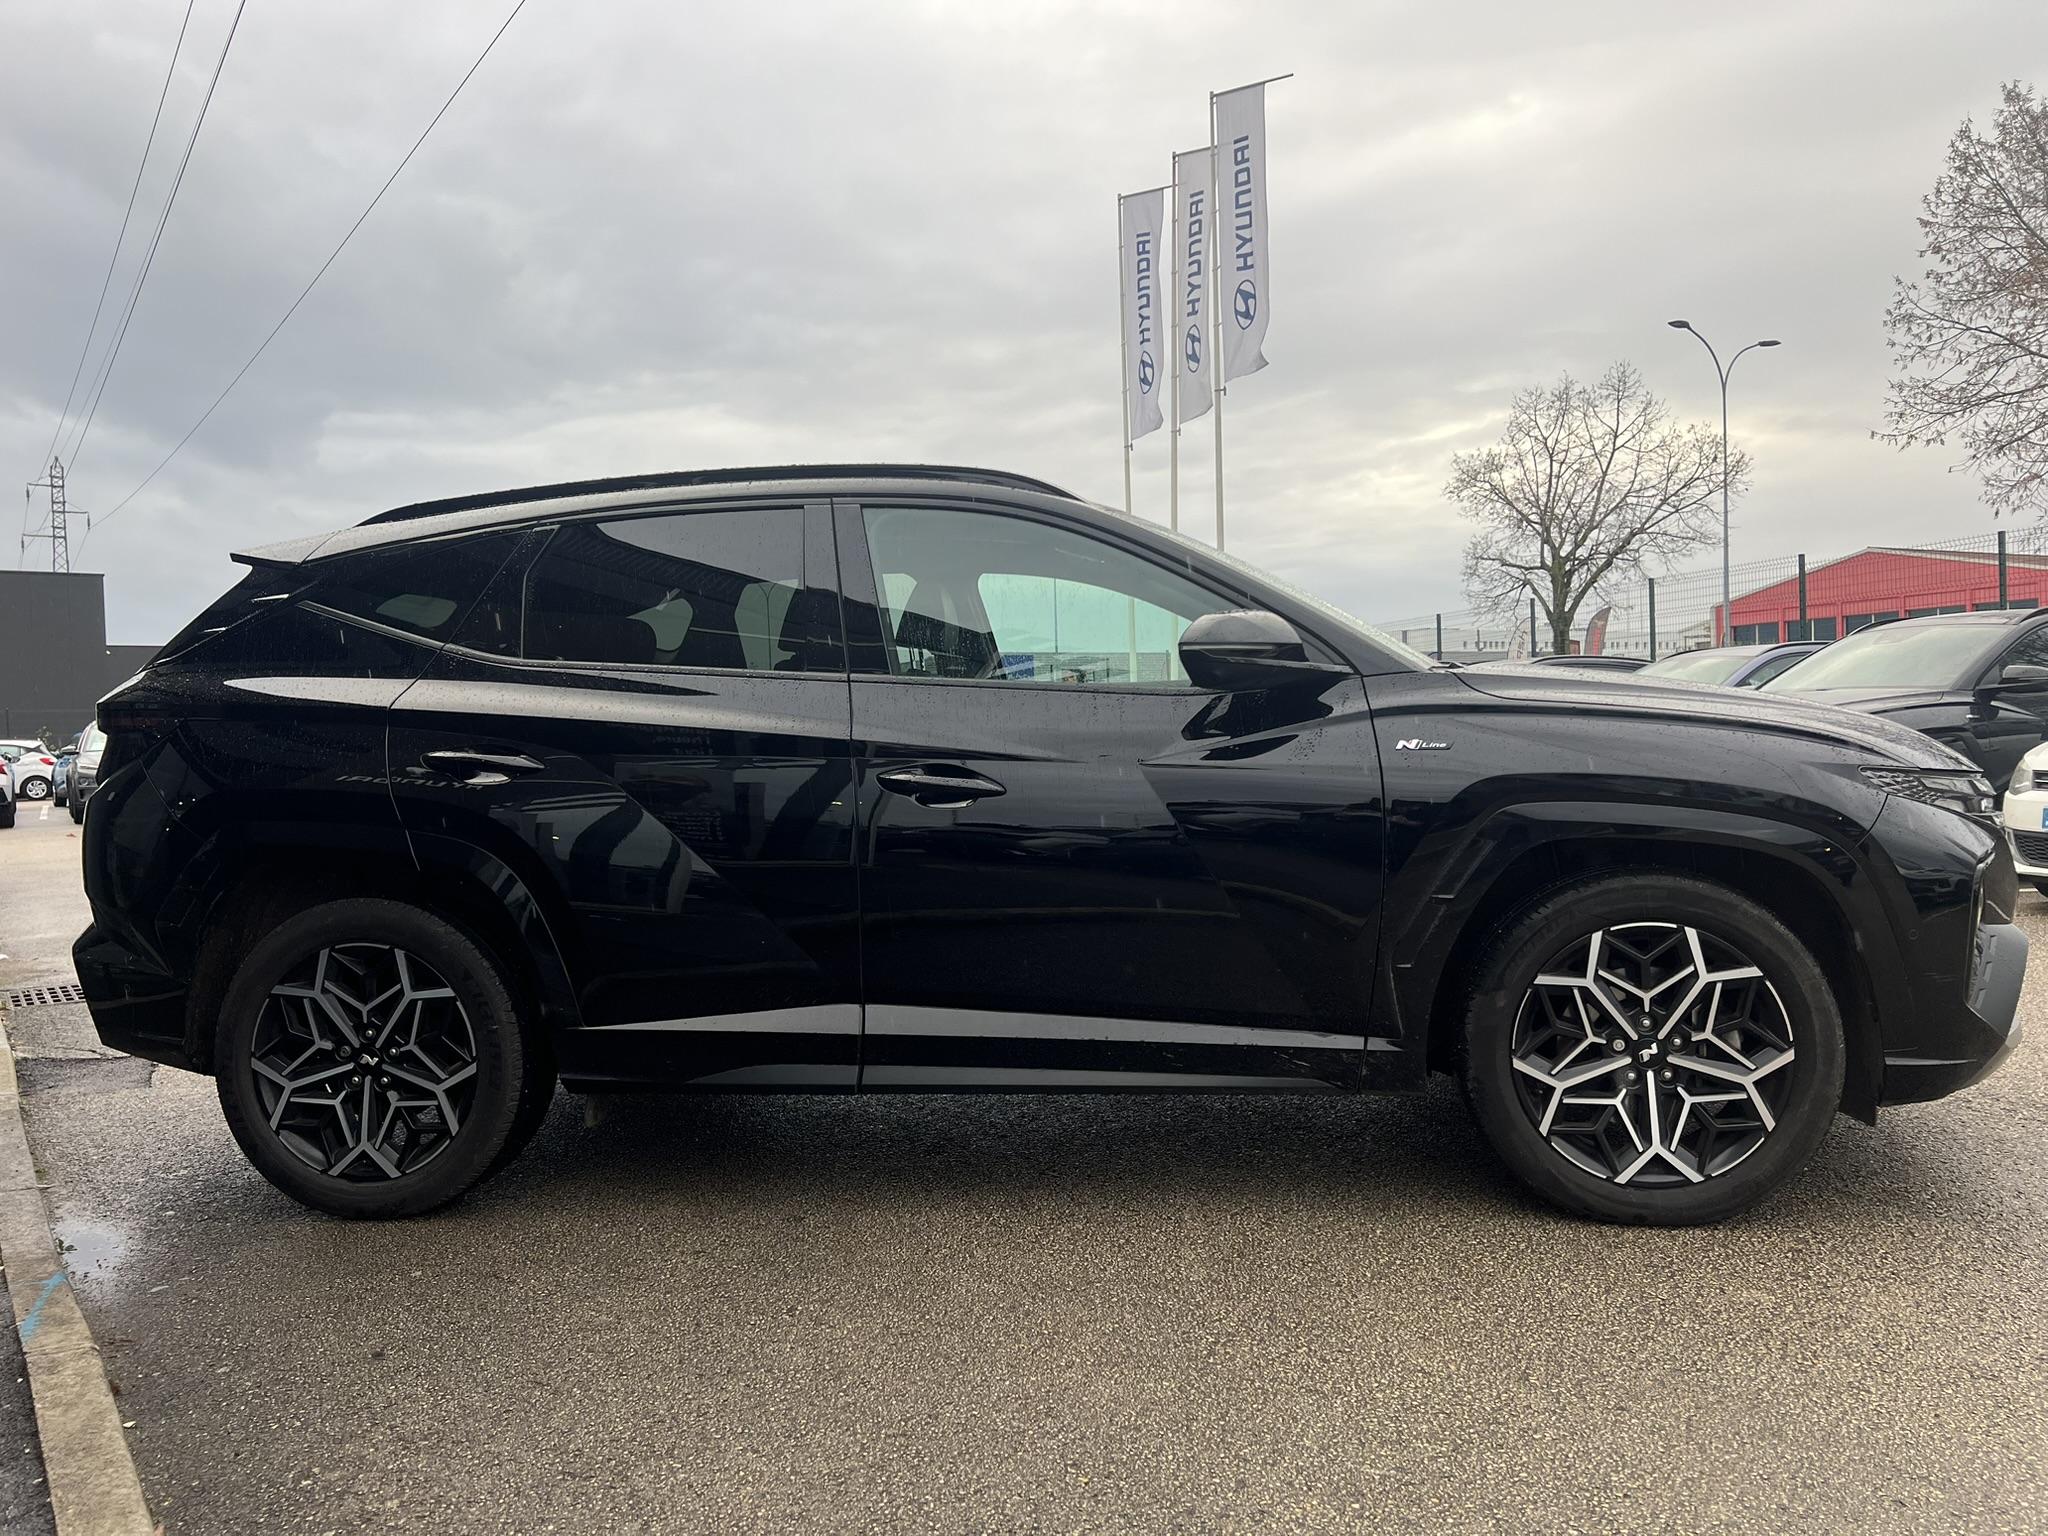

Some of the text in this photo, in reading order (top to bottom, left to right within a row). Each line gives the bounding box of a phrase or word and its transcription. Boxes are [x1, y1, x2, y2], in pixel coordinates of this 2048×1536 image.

[1187, 190, 1204, 317] HYUNDAI
[1233, 135, 1254, 271] HYUNDAI
[1137, 231, 1151, 345] HYUNDAI
